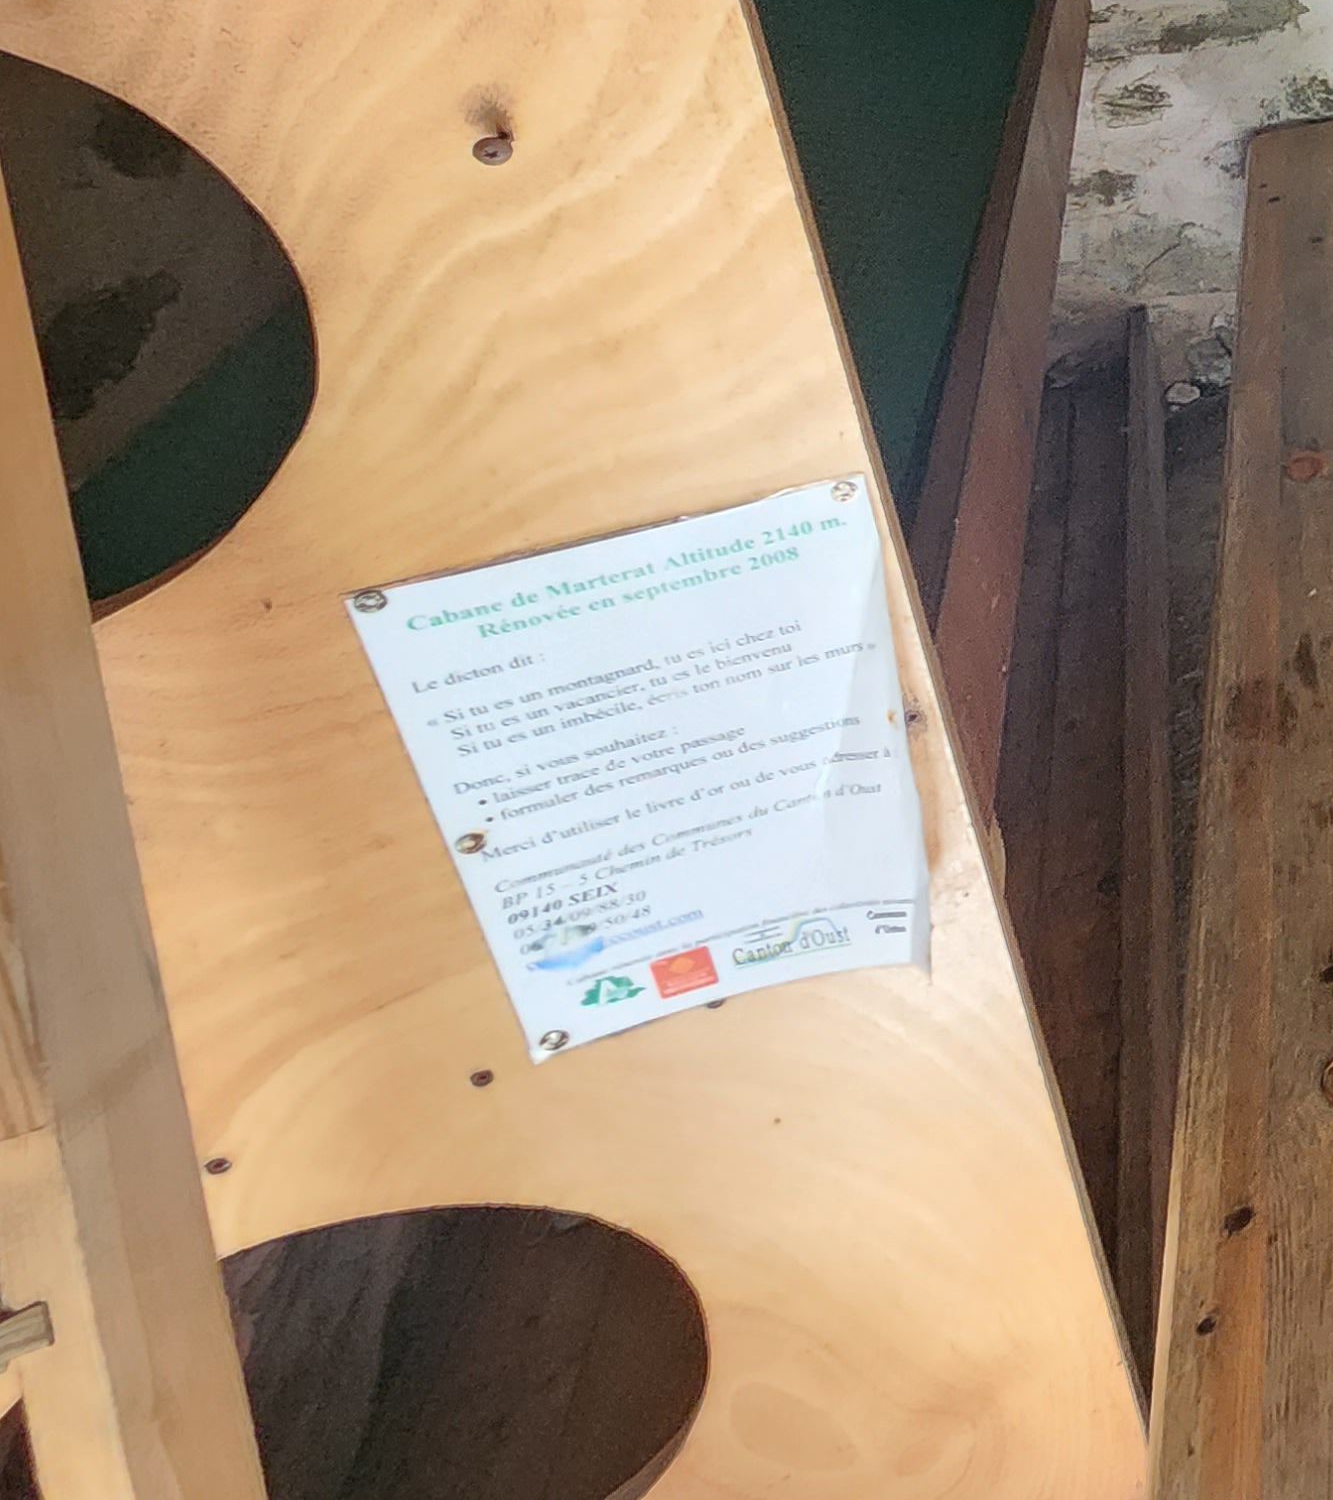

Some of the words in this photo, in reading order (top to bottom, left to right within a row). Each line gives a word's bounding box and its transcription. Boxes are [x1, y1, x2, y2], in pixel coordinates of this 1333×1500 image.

[406, 601, 502, 631] Cabane
[511, 592, 539, 608] de
[545, 561, 655, 597] Marterat
[664, 537, 756, 571] Altitude
[820, 517, 847, 531] m.
[477, 603, 582, 638] Rénovée
[588, 596, 616, 612] en
[622, 562, 742, 603] septembre
[749, 546, 800, 572] 2008
[411, 679, 438, 694] Le
[444, 661, 504, 686] dicton
[508, 653, 534, 670] dit
[443, 704, 465, 723] Si
[469, 703, 489, 717] tu
[494, 696, 514, 711] es
[519, 690, 544, 704] un
[548, 658, 659, 697] montagnard,
[664, 652, 682, 666] tu
[687, 646, 705, 660] es
[708, 638, 731, 653] ici
[736, 629, 774, 647] chez
[779, 620, 802, 637] toi
[450, 726, 472, 741] Si
[477, 720, 496, 734] tu
[501, 714, 521, 727] es
[526, 707, 550, 721] un
[553, 679, 646, 712] vacancier,
[649, 675, 668, 688] tu
[673, 669, 691, 682] es
[695, 661, 711, 676] le
[715, 642, 793, 671] bienvenu
[457, 740, 479, 757] Si
[483, 736, 502, 750] tu
[507, 730, 528, 744] es
[532, 724, 556, 737] un
[560, 699, 644, 729] imbécile,
[693, 679, 720, 694] ton
[725, 668, 763, 686] nom
[767, 659, 793, 675] sur
[824, 642, 864, 660] murs
[453, 773, 512, 796] Donc,
[515, 764, 531, 778] si
[535, 754, 580, 772] vous
[584, 729, 667, 760] souhaitez
[492, 779, 552, 804] laisser
[557, 766, 600, 785] trace
[605, 758, 626, 772] de
[631, 745, 675, 764] votre
[680, 726, 746, 754] passage
[500, 790, 580, 821] formuler
[584, 781, 615, 798] des
[619, 754, 707, 787] remarques
[712, 748, 734, 762] ou
[738, 740, 766, 755] des
[769, 715, 861, 746] suggestions
[481, 836, 536, 863] Merci
[626, 805, 642, 820] le
[646, 795, 685, 815] livre
[730, 778, 751, 790] ou
[755, 771, 774, 784] de
[779, 761, 817, 777] vous
[494, 846, 614, 894] Communauté
[618, 842, 645, 857] des
[651, 811, 744, 847] Communes
[748, 804, 769, 820] du
[501, 892, 529, 910] BP
[536, 882, 557, 899] 15
[579, 873, 588, 887] 5
[595, 854, 662, 880] Chemin
[666, 847, 687, 861] de
[507, 899, 563, 925] 09140
[568, 882, 619, 907] SEIX
[732, 939, 793, 966] Canton
